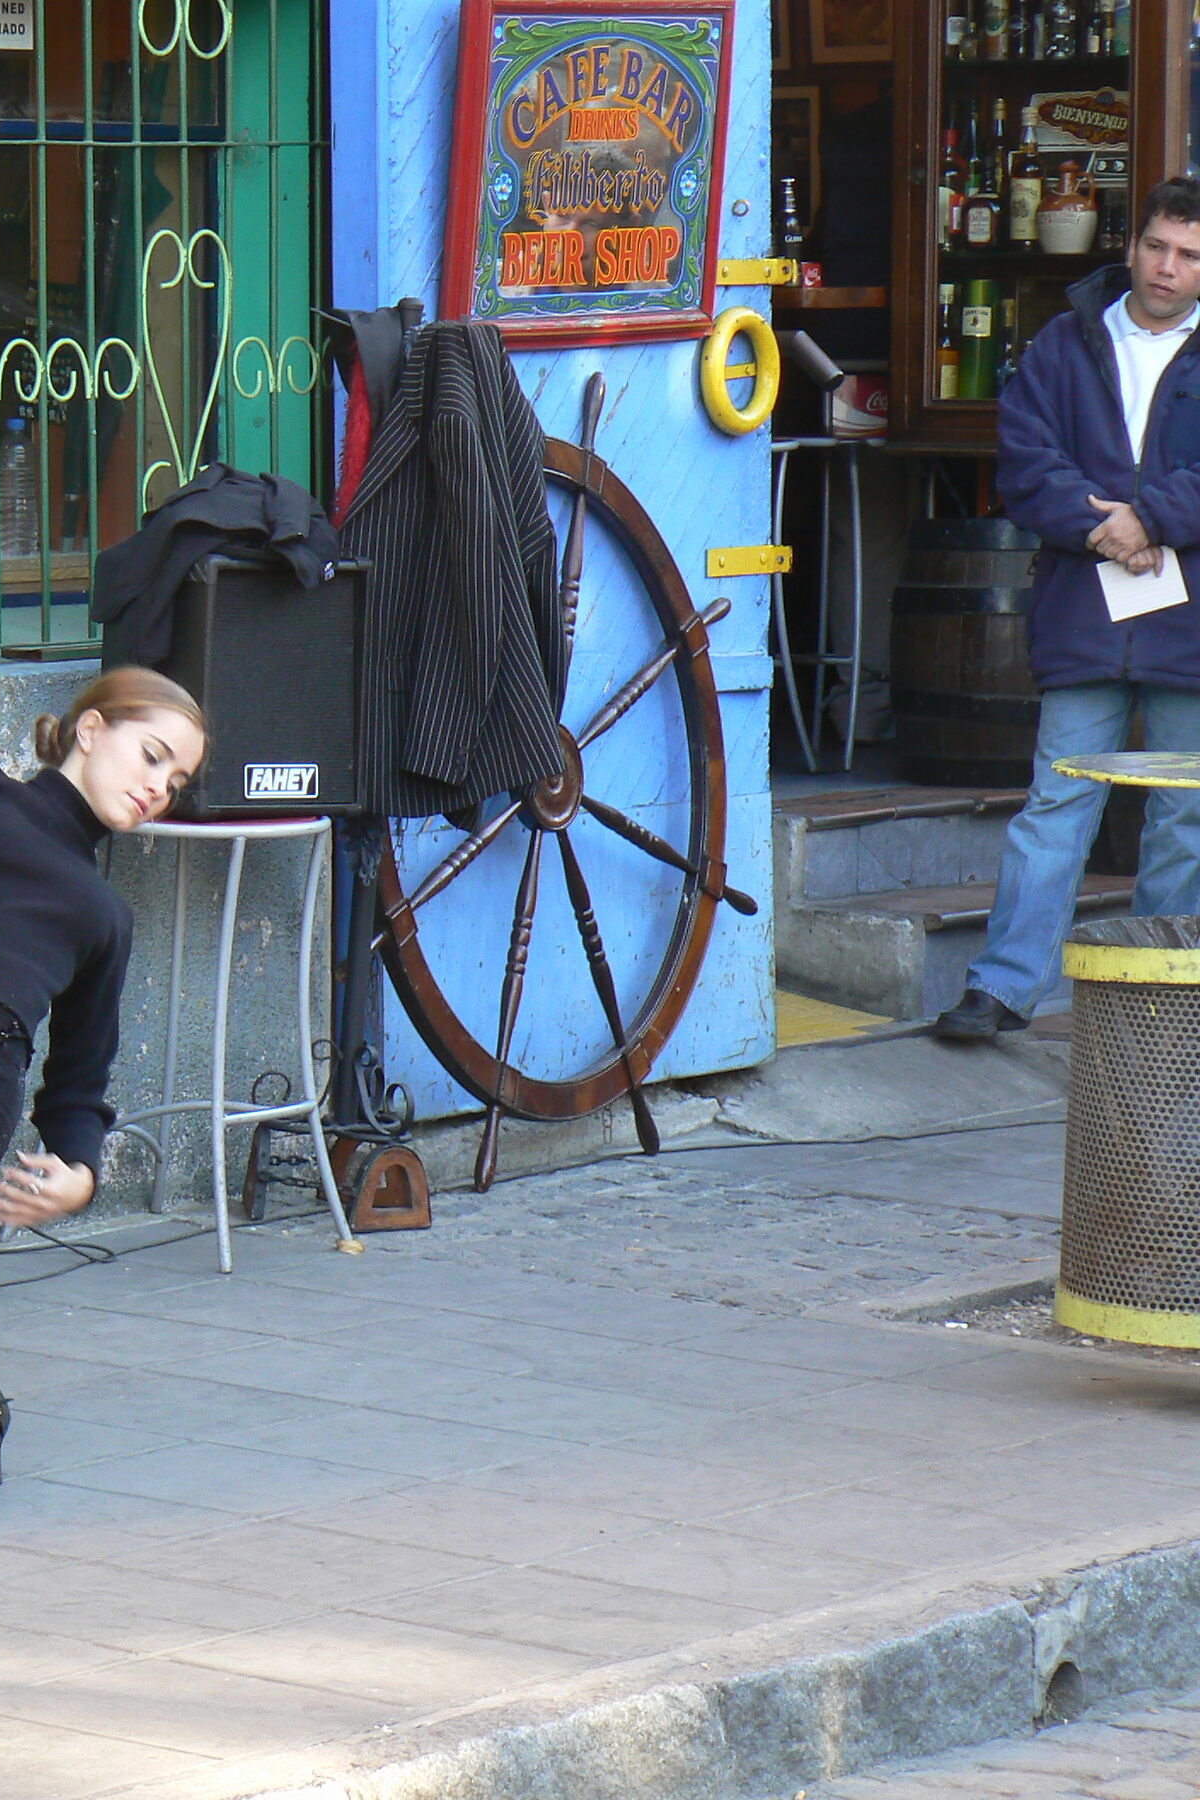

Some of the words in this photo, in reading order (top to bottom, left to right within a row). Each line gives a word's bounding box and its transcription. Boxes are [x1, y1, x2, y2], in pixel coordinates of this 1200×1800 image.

[507, 45, 611, 149] CAFE
[616, 48, 693, 152] BAR
[568, 107, 639, 142] DRINKS
[524, 149, 666, 225] Filiberto
[501, 230, 587, 287] BEER
[595, 226, 680, 287] SHOP
[249, 767, 316, 795] FAHEY
